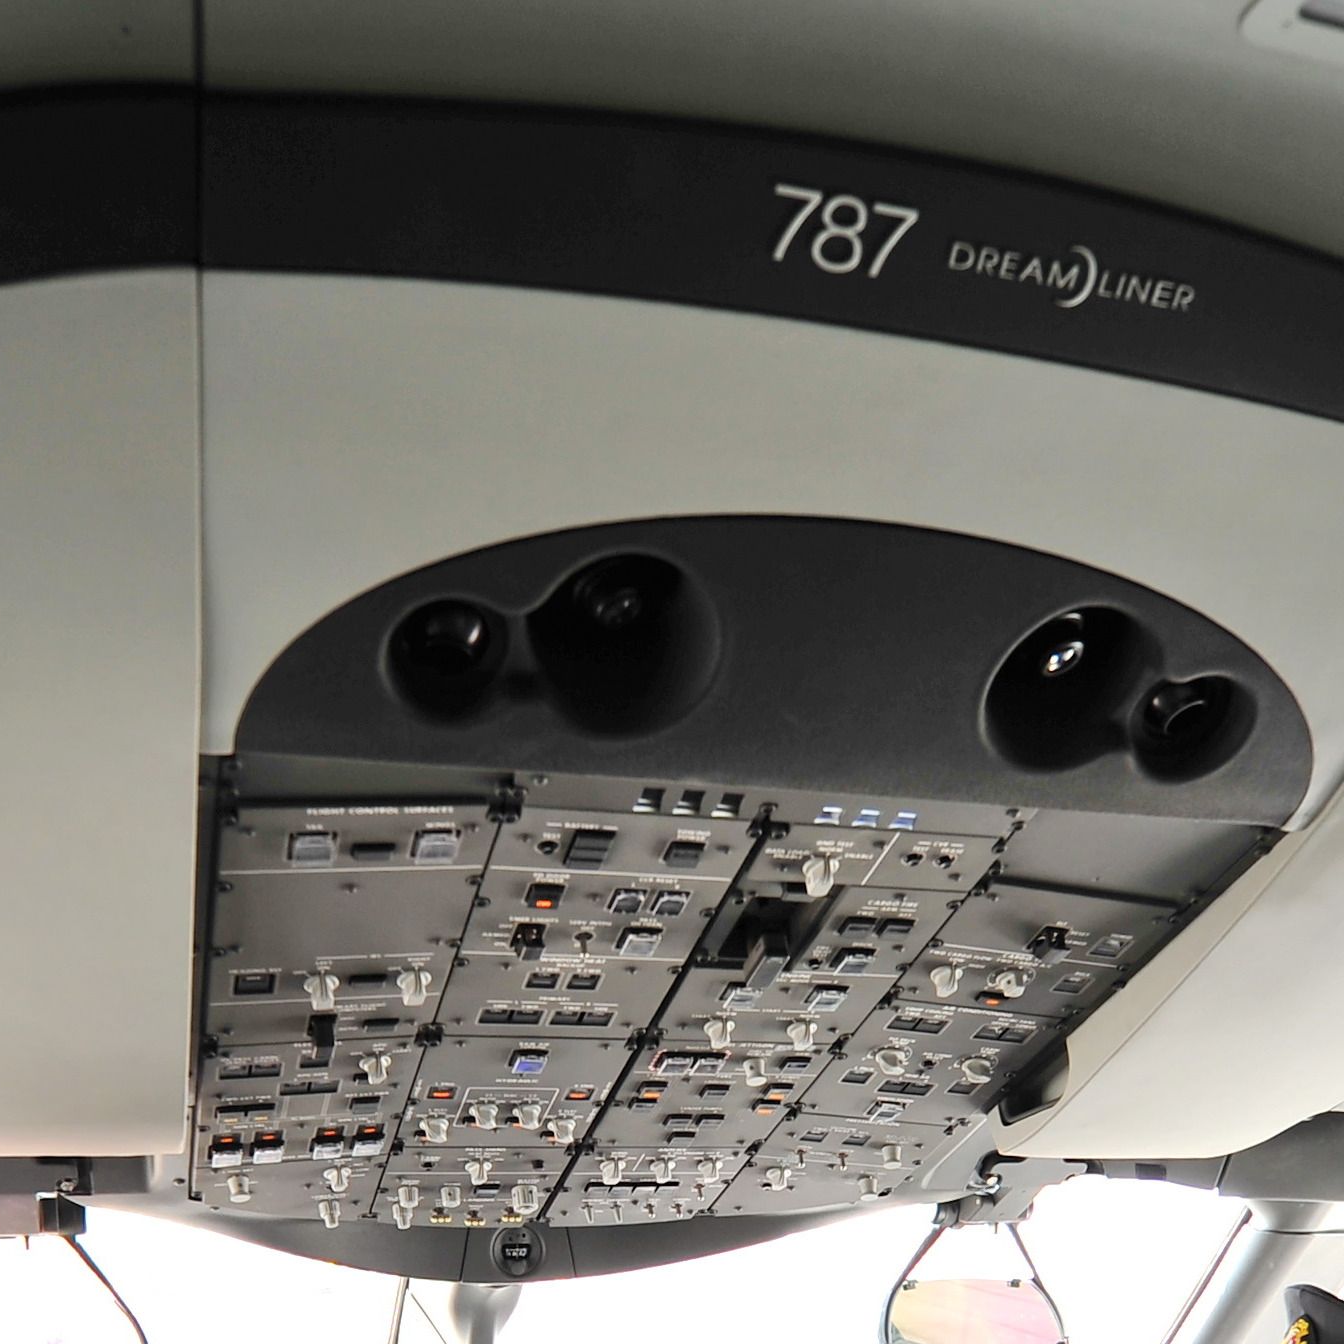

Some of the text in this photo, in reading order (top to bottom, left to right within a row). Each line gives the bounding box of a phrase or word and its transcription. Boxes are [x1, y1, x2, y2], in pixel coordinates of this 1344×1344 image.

[772, 183, 1196, 313] 787 DREAMLINER
[348, 807, 400, 816] CONTROL
[403, 805, 455, 815] SURFACES
